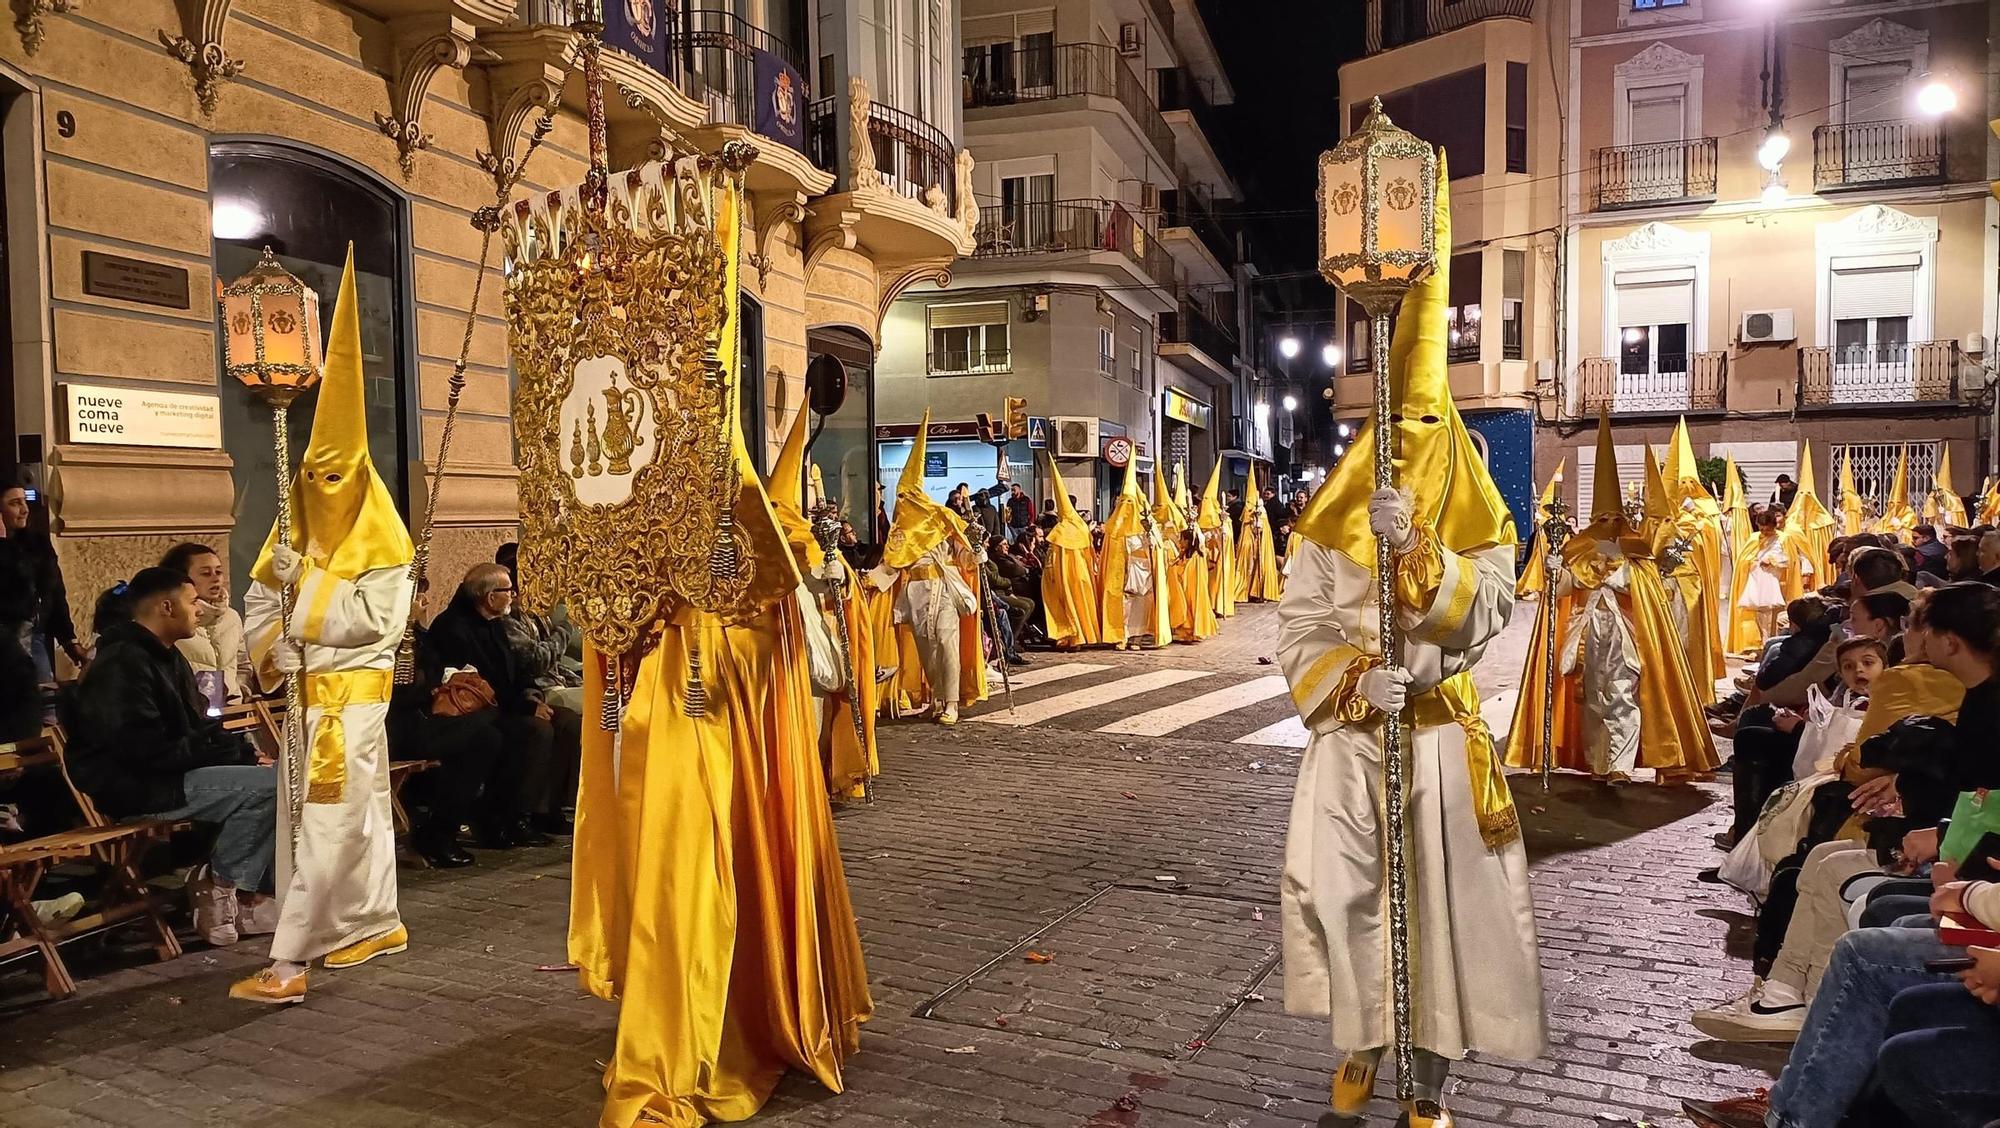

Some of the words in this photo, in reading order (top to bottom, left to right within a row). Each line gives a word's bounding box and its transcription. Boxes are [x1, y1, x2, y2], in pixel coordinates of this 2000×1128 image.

[56, 110, 76, 138] 9
[78, 396, 123, 408] nueve
[141, 400, 168, 409] Agencia
[169, 402, 178, 410] de
[78, 409, 119, 421] coma
[160, 411, 193, 419] marketing
[79, 422, 124, 433] nueve
[930, 425, 960, 435] Bar
